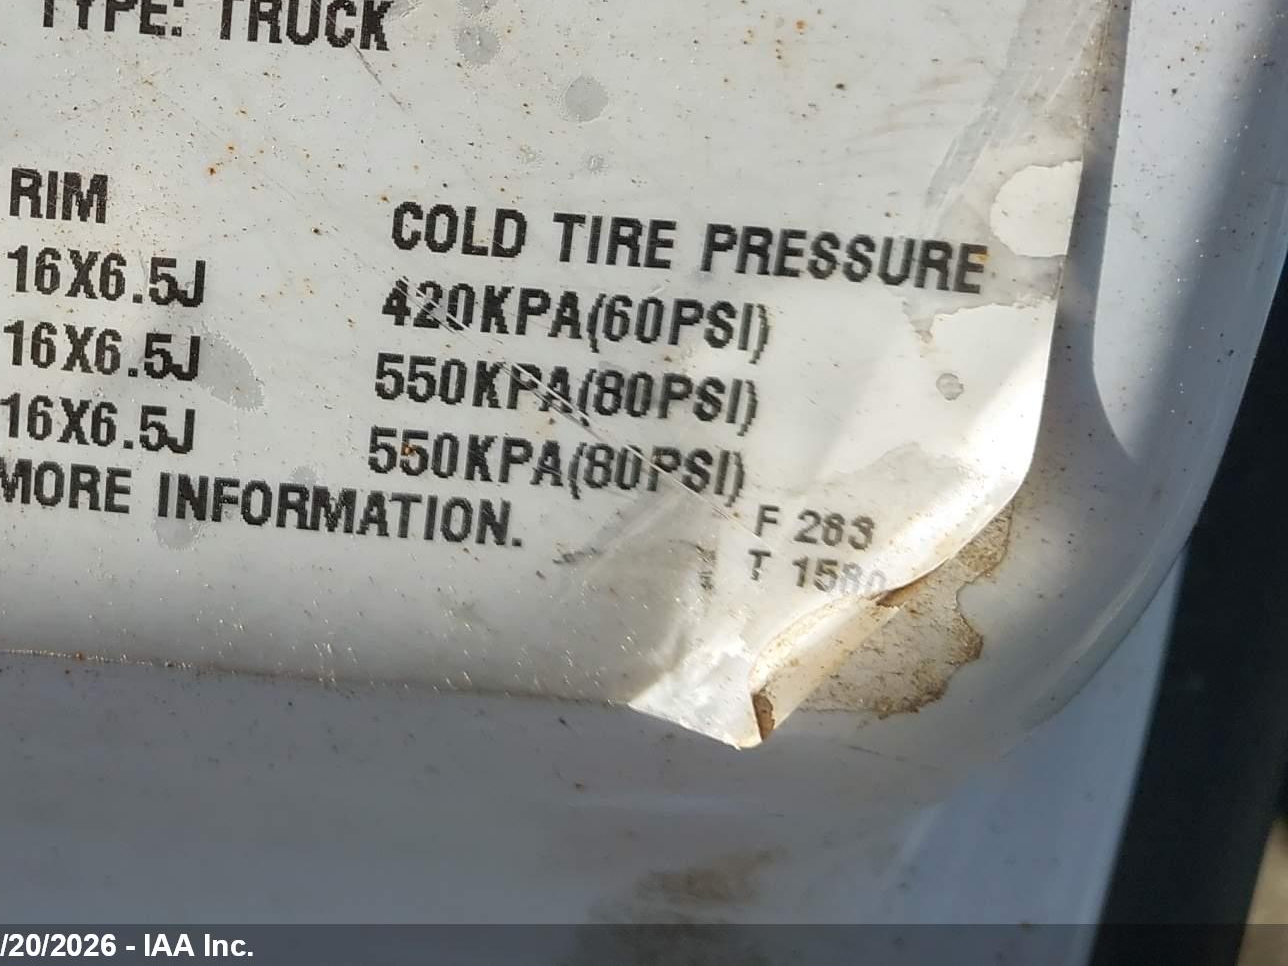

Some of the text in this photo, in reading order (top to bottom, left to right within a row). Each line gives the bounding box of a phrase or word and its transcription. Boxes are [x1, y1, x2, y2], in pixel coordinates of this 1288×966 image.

[9, 166, 108, 224] RIM
[6, 245, 207, 308] 16X6.5J
[391, 200, 990, 294] COLD TIRE PRESSURE
[3, 319, 200, 382] 16X6.5J
[382, 278, 771, 363] 420KPA(60PSI)
[0, 393, 196, 454] 16X6.5J
[373, 353, 758, 436] 550KPA(80PSI)
[367, 425, 746, 508] 550KPA(80PSI)
[157, 471, 523, 548] INFORMATION.
[755, 504, 780, 537] F
[748, 549, 772, 581] T
